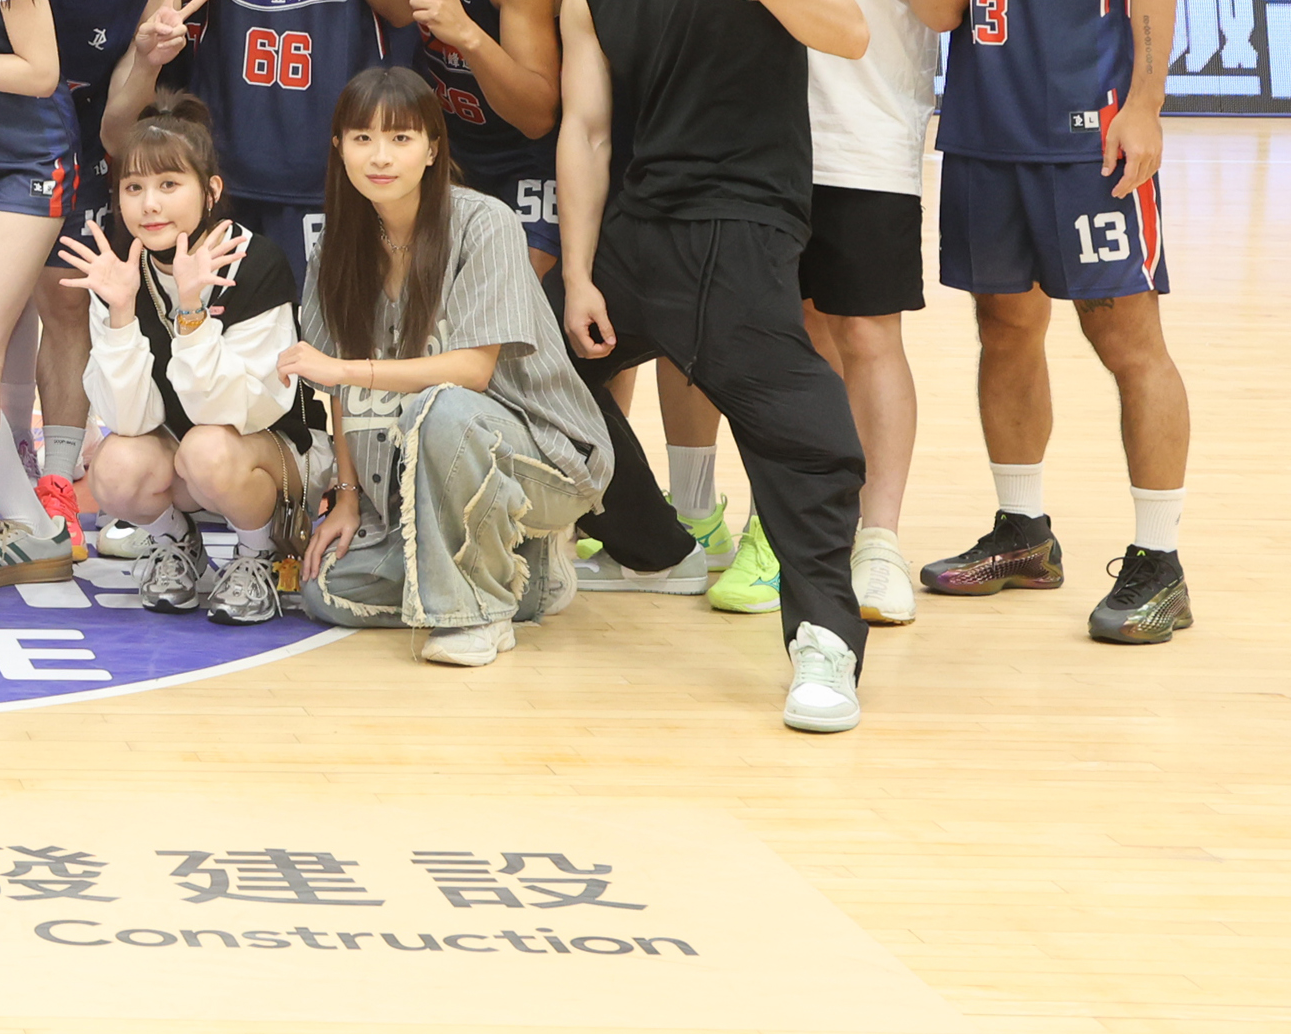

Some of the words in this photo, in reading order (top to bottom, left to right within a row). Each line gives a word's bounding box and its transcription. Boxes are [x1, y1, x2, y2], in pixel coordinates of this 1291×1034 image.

[242, 26, 313, 91] 66
[1073, 210, 1130, 265] 13
[33, 917, 700, 958] Construction
